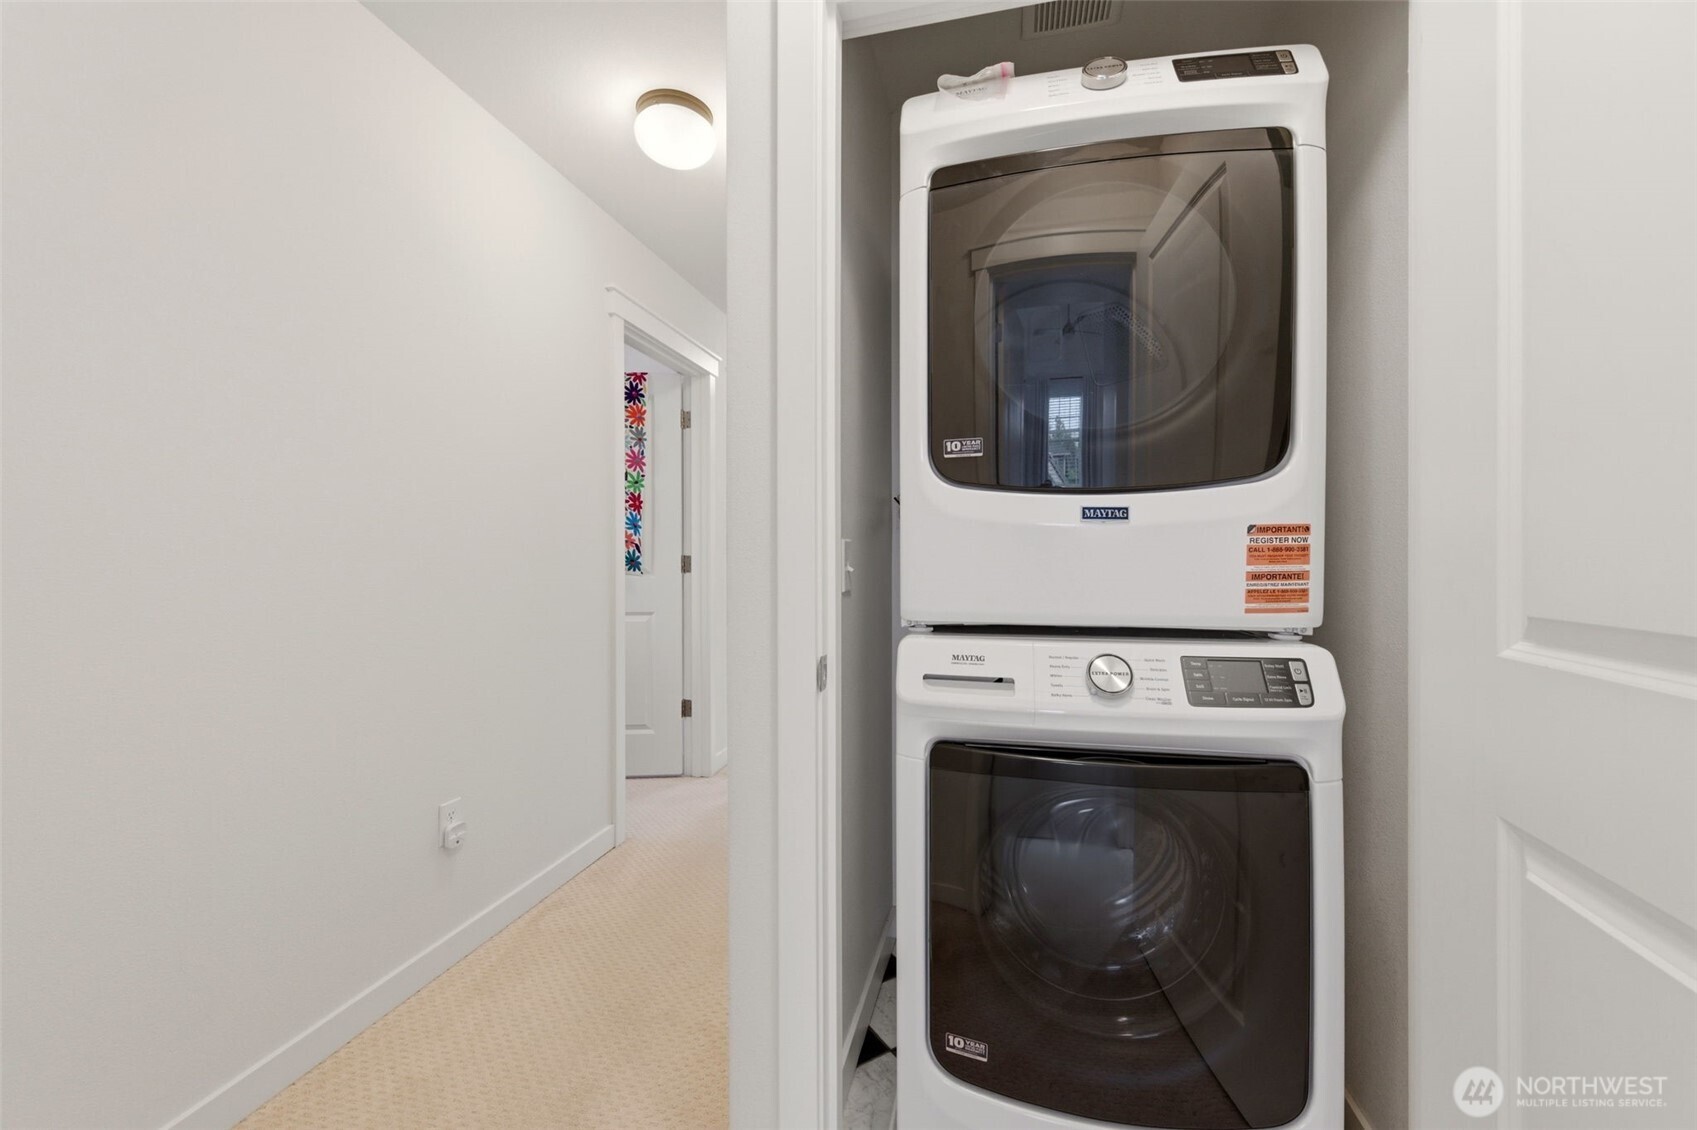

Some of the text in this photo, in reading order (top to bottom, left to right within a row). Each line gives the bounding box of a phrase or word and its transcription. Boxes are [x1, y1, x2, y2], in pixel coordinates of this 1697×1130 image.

[945, 441, 961, 452] 10
[1083, 508, 1128, 518] MAYTAG
[952, 654, 985, 662] MAYTAG
[948, 1035, 985, 1049] 10 YEAR
